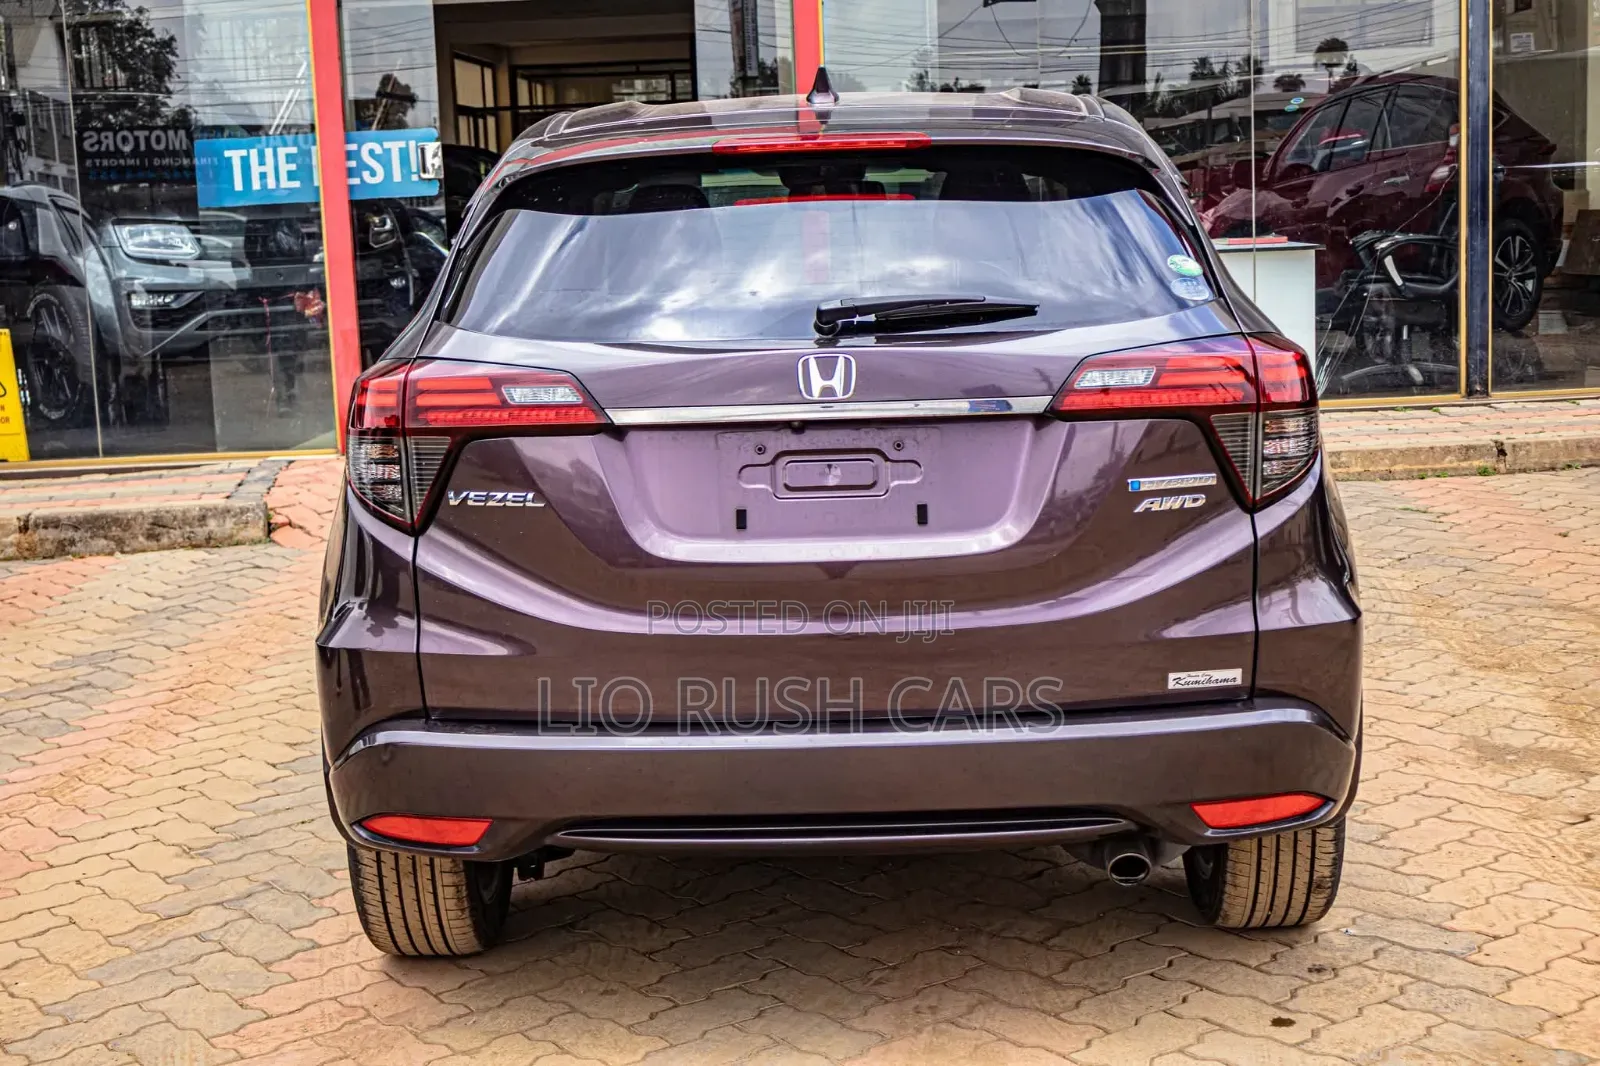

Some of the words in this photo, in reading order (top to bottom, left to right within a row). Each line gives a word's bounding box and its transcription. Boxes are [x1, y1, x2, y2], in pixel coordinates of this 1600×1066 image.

[224, 146, 301, 191] THE
[311, 140, 419, 187] EST!
[447, 490, 546, 507] VEZEL
[1133, 494, 1206, 513] AWD
[1171, 674, 1238, 687] Kumihama
